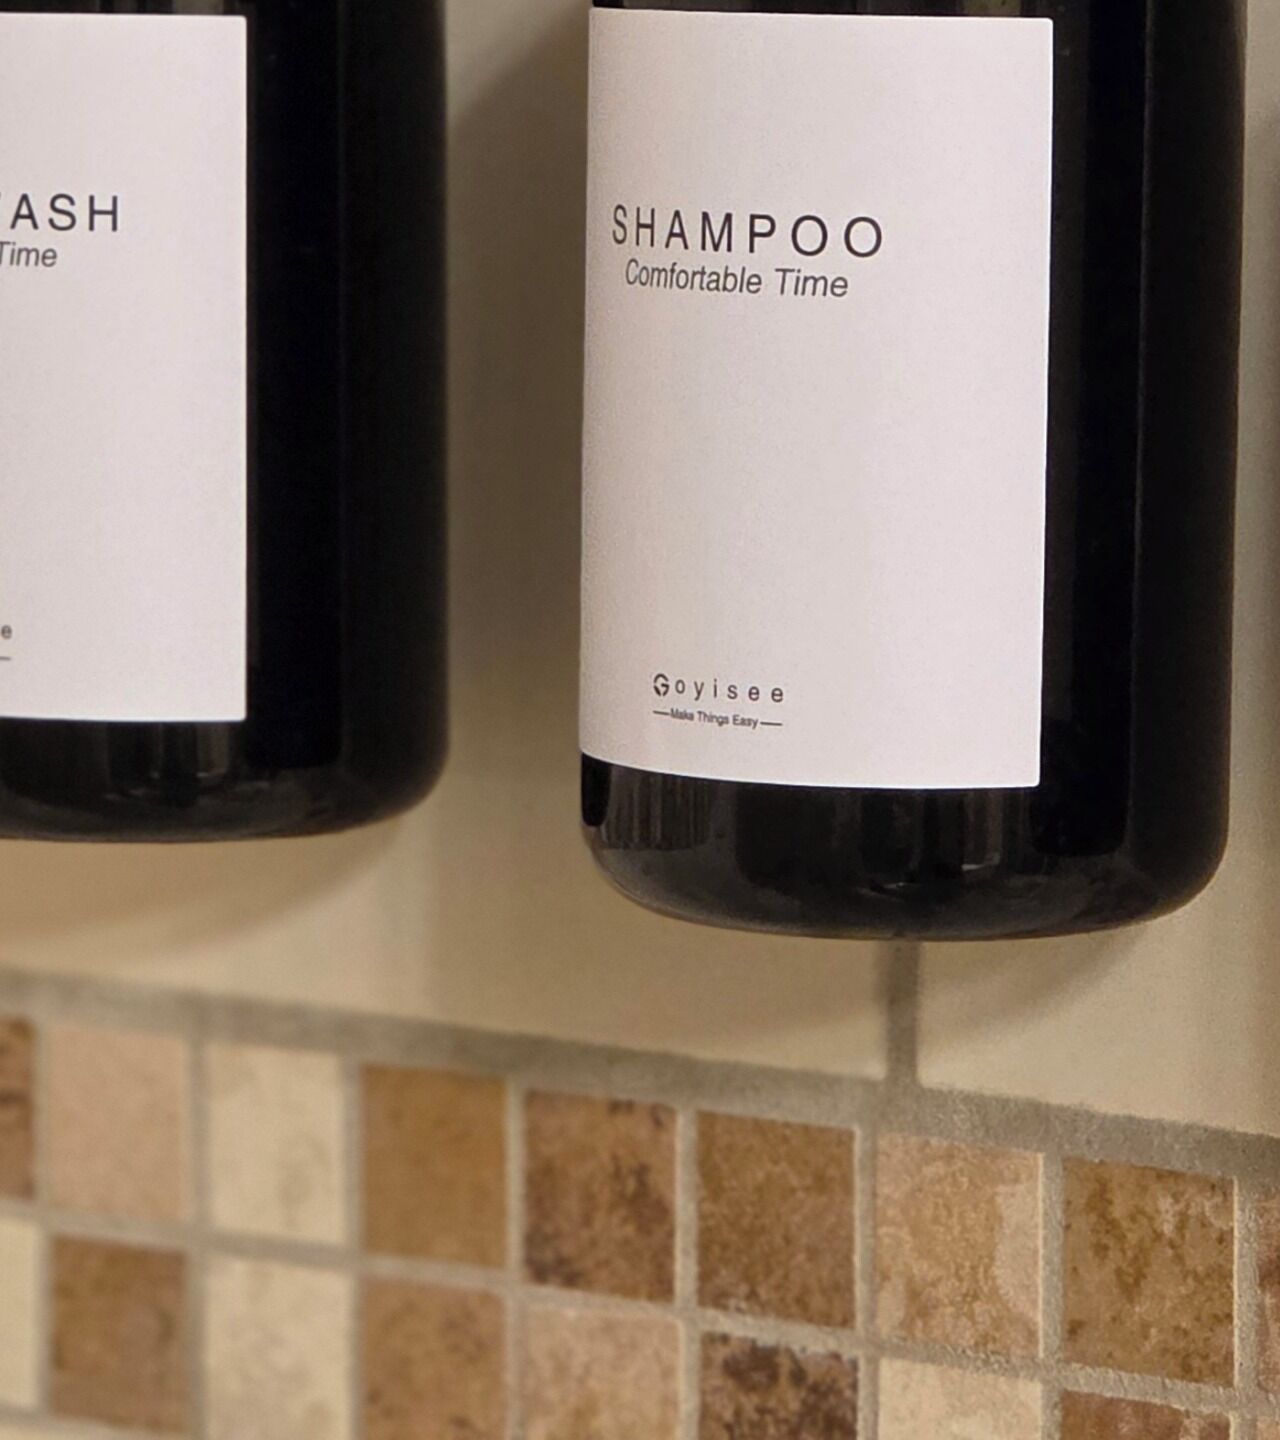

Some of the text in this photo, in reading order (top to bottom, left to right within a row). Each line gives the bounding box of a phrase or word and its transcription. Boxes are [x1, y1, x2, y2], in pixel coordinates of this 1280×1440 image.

[611, 203, 883, 258] SHAMPOO
[625, 257, 849, 298] Comfortable Time
[653, 672, 784, 703] Goyisee
[697, 710, 729, 727] Things
[732, 714, 759, 730] Easy
